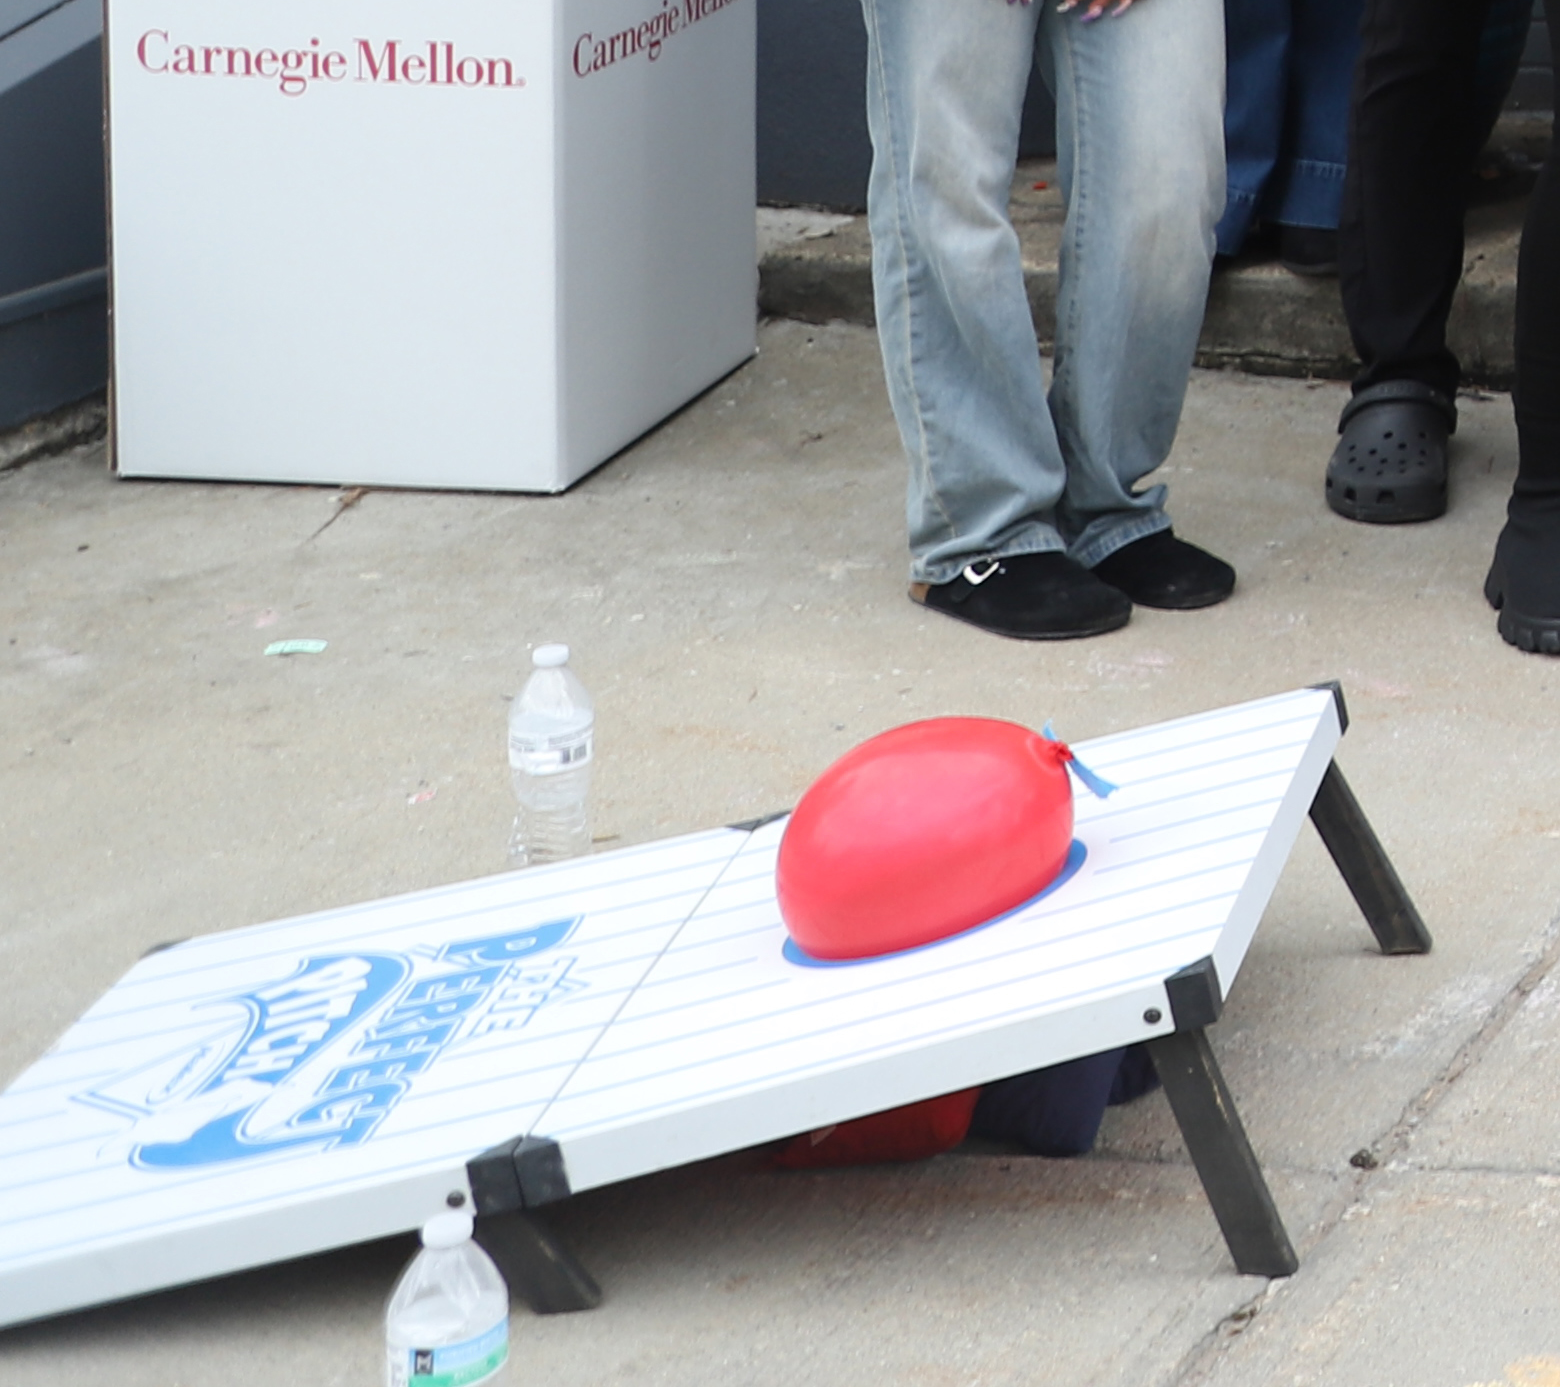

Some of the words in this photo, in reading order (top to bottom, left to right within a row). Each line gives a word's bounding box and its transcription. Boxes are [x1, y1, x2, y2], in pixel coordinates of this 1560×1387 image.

[135, 29, 348, 96] Carnegie
[352, 38, 519, 89] Mellon
[222, 956, 374, 1080] PITCH
